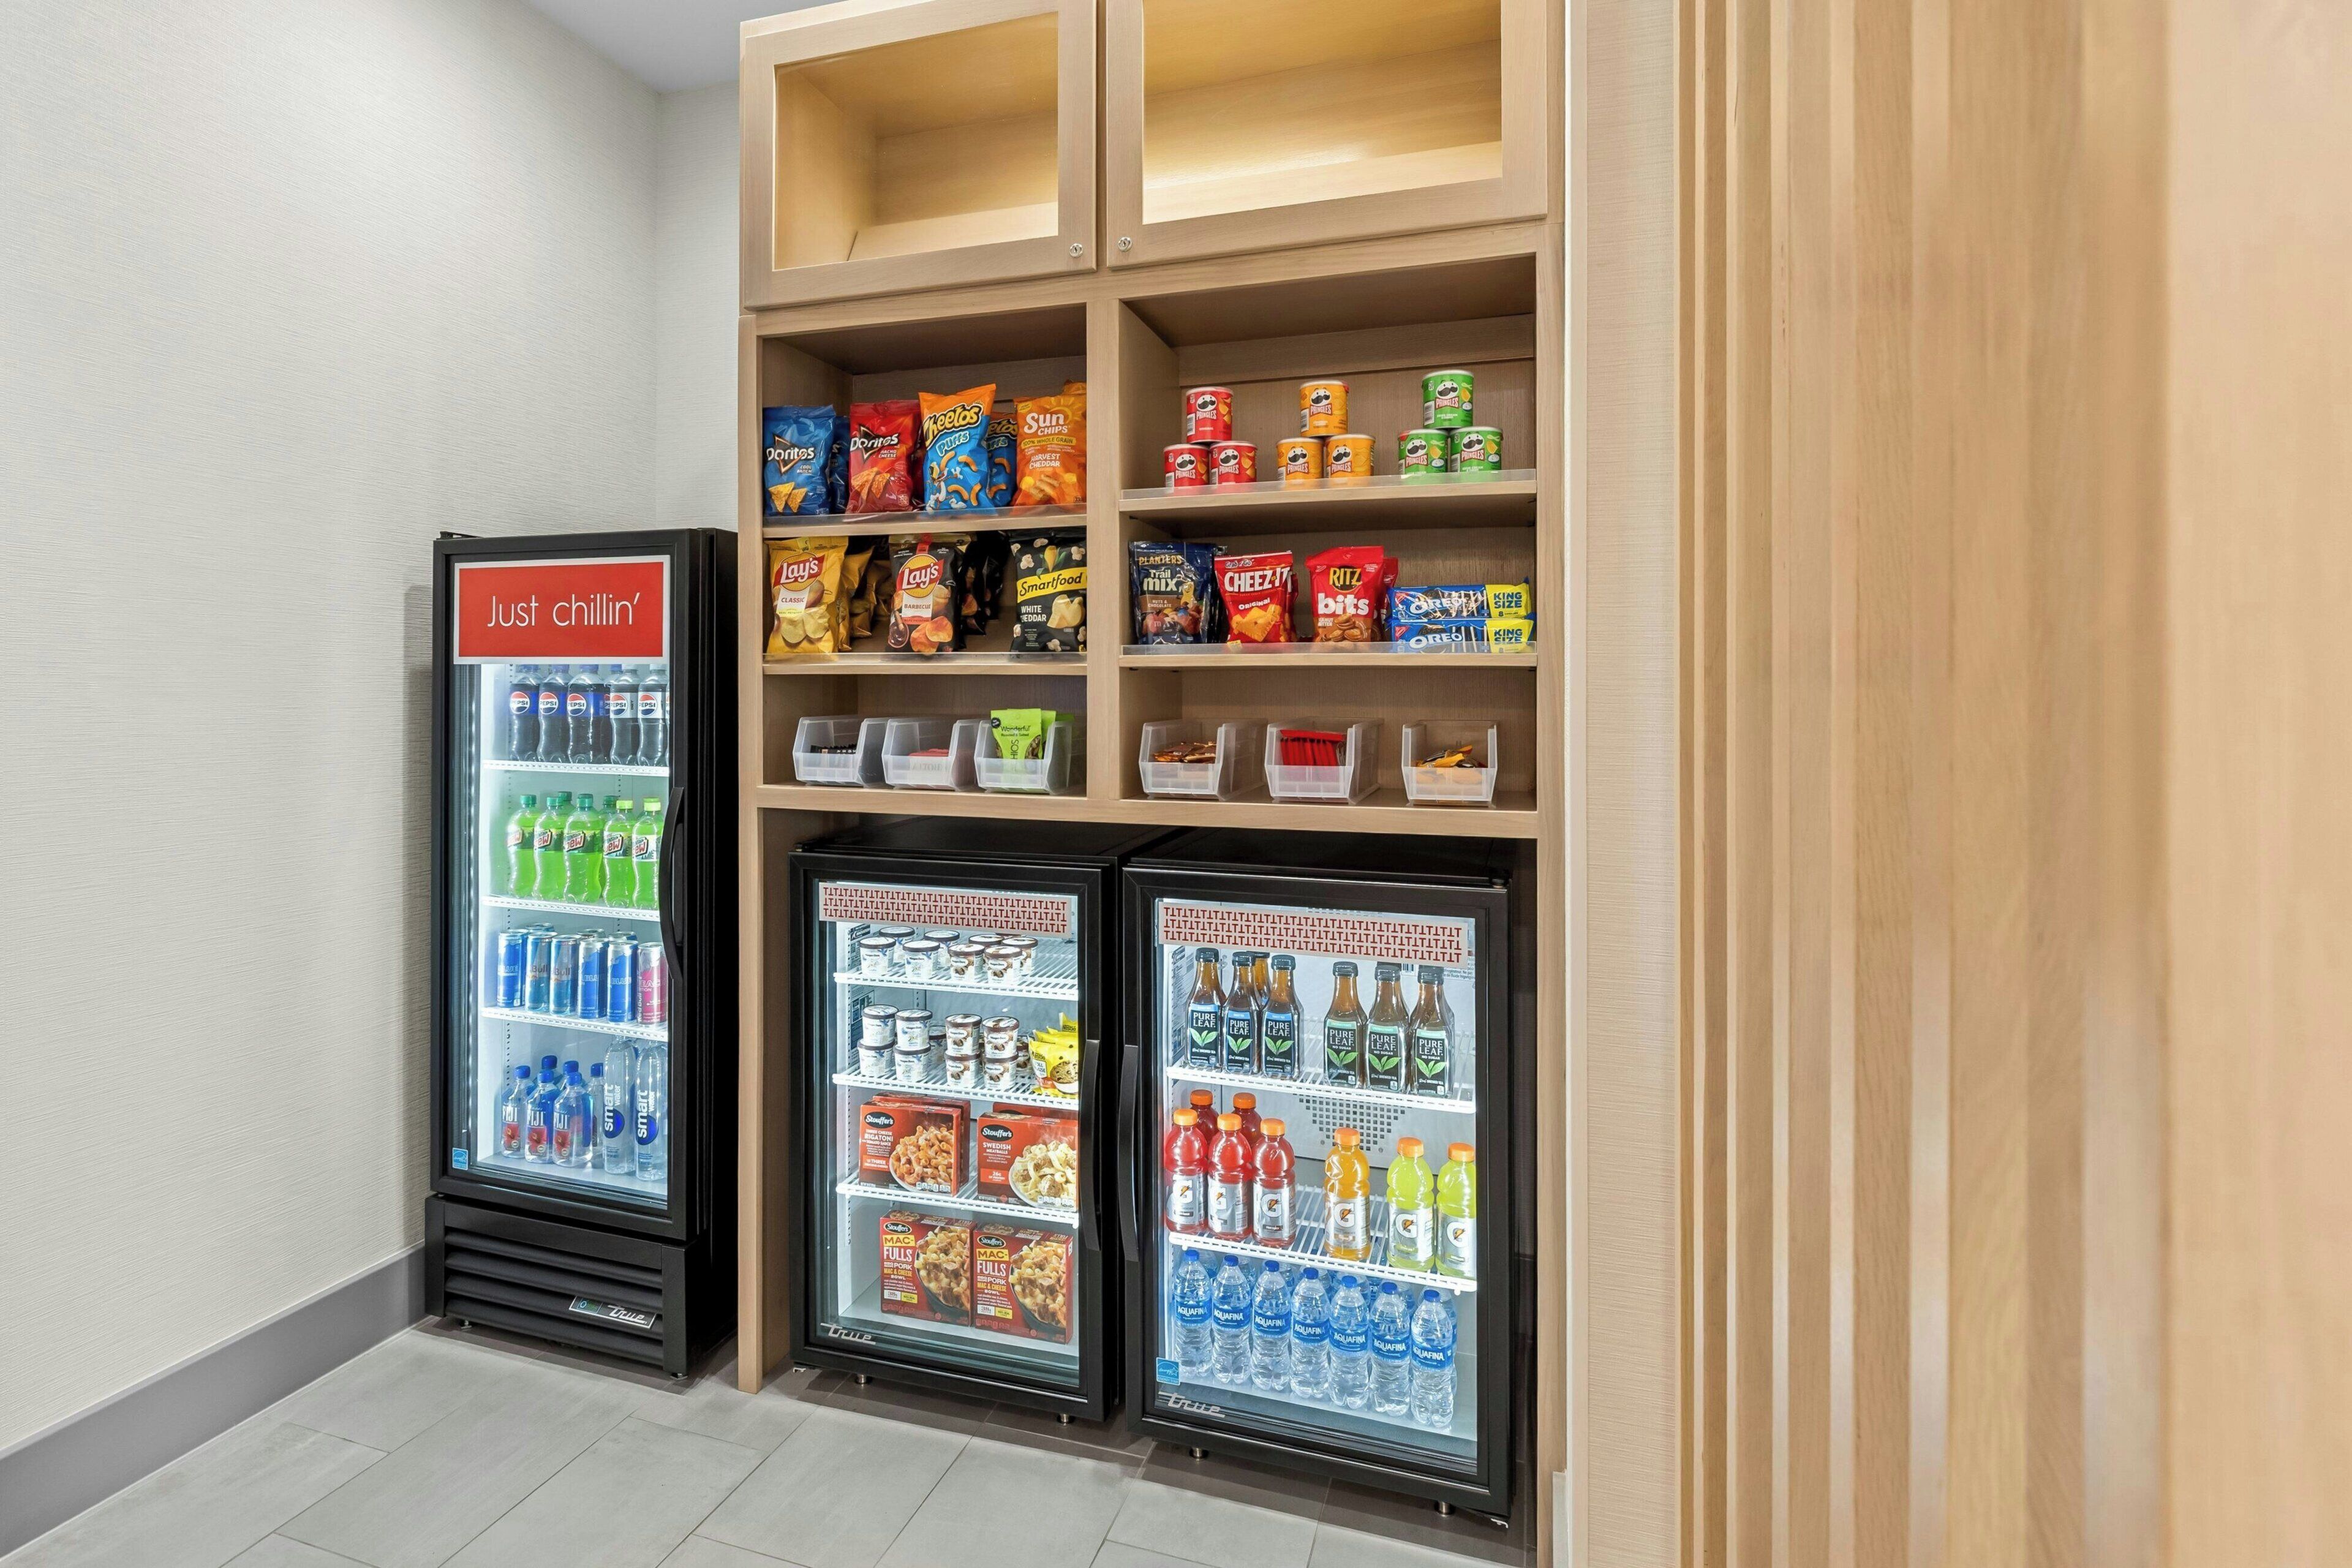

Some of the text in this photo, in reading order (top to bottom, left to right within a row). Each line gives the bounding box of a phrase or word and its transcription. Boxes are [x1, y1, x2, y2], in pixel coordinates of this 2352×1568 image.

[1436, 397, 1458, 409] PRINGLES
[1196, 410, 1217, 421] PRINGLES
[1310, 404, 1332, 415] PRINGLES
[924, 404, 982, 445] Cheetos
[1023, 412, 1065, 434] Sun
[1038, 426, 1068, 435] CHIPS
[850, 432, 900, 452] Doritos
[937, 431, 970, 456] PUFFS
[766, 447, 815, 461] Doritos
[1030, 453, 1061, 462] HARVEST
[1461, 450, 1484, 462] PRINGLES
[1029, 461, 1060, 470] CHEDDAR
[1332, 461, 1352, 473] PRINGLES
[1406, 455, 1427, 467] PRINGLES
[1175, 469, 1196, 480] PRINGLES
[1219, 464, 1239, 475] PRINGLES
[1287, 463, 1308, 474] PRINGLES
[1139, 555, 1182, 565] PLANTERS
[780, 557, 820, 584] Lay's
[902, 562, 940, 589] Lay's
[1149, 570, 1171, 578] Trail
[1329, 567, 1363, 586] RITZ
[1019, 572, 1084, 597] Smartfood
[1144, 578, 1178, 592] mix
[1224, 567, 1291, 592] CHEEZ-IT
[1493, 592, 1523, 600] KING
[488, 592, 640, 627] Just chillin'
[1317, 592, 1370, 616] bits
[1410, 597, 1464, 614] OREO
[1494, 600, 1522, 609] SIZE
[1494, 628, 1523, 637] KING
[1409, 632, 1463, 649] OREO
[554, 967, 570, 976] Bull
[1193, 1012, 1216, 1021] PURE
[1230, 1020, 1249, 1028] PURE
[1268, 1020, 1290, 1030] PURE
[1330, 1029, 1354, 1039] PURE
[1371, 1034, 1396, 1044] PURE
[1419, 1039, 1443, 1048] PURE
[605, 1085, 614, 1132] smart
[638, 1090, 648, 1138] smart
[865, 1115, 894, 1126] Stouffer's
[864, 1133, 894, 1142] RIGATONI
[982, 1128, 1012, 1138] Stouffer's
[982, 1142, 1011, 1150] SWEDISH
[1172, 1179, 1193, 1204] G
[1261, 1193, 1282, 1218] G
[1333, 1203, 1355, 1227] G
[886, 1224, 909, 1232] Stouffer's
[1395, 1213, 1418, 1238] G
[884, 1237, 914, 1245] MAC-
[981, 1237, 1003, 1246] Stouffer's
[884, 1246, 912, 1262] FULLS
[977, 1250, 1008, 1259] MAC-
[977, 1260, 1006, 1277] FULLS
[987, 1276, 1007, 1285] PORK
[1177, 1305, 1207, 1317] AQUAFINA
[1214, 1309, 1243, 1321] AQUAFINA
[1254, 1316, 1286, 1327] AQUAFINA
[1295, 1324, 1325, 1337] AQUAFINA
[1334, 1333, 1365, 1344] AQUAFINA
[1374, 1339, 1406, 1351] AQUAFINA
[1413, 1347, 1445, 1361] AQUAFINA
